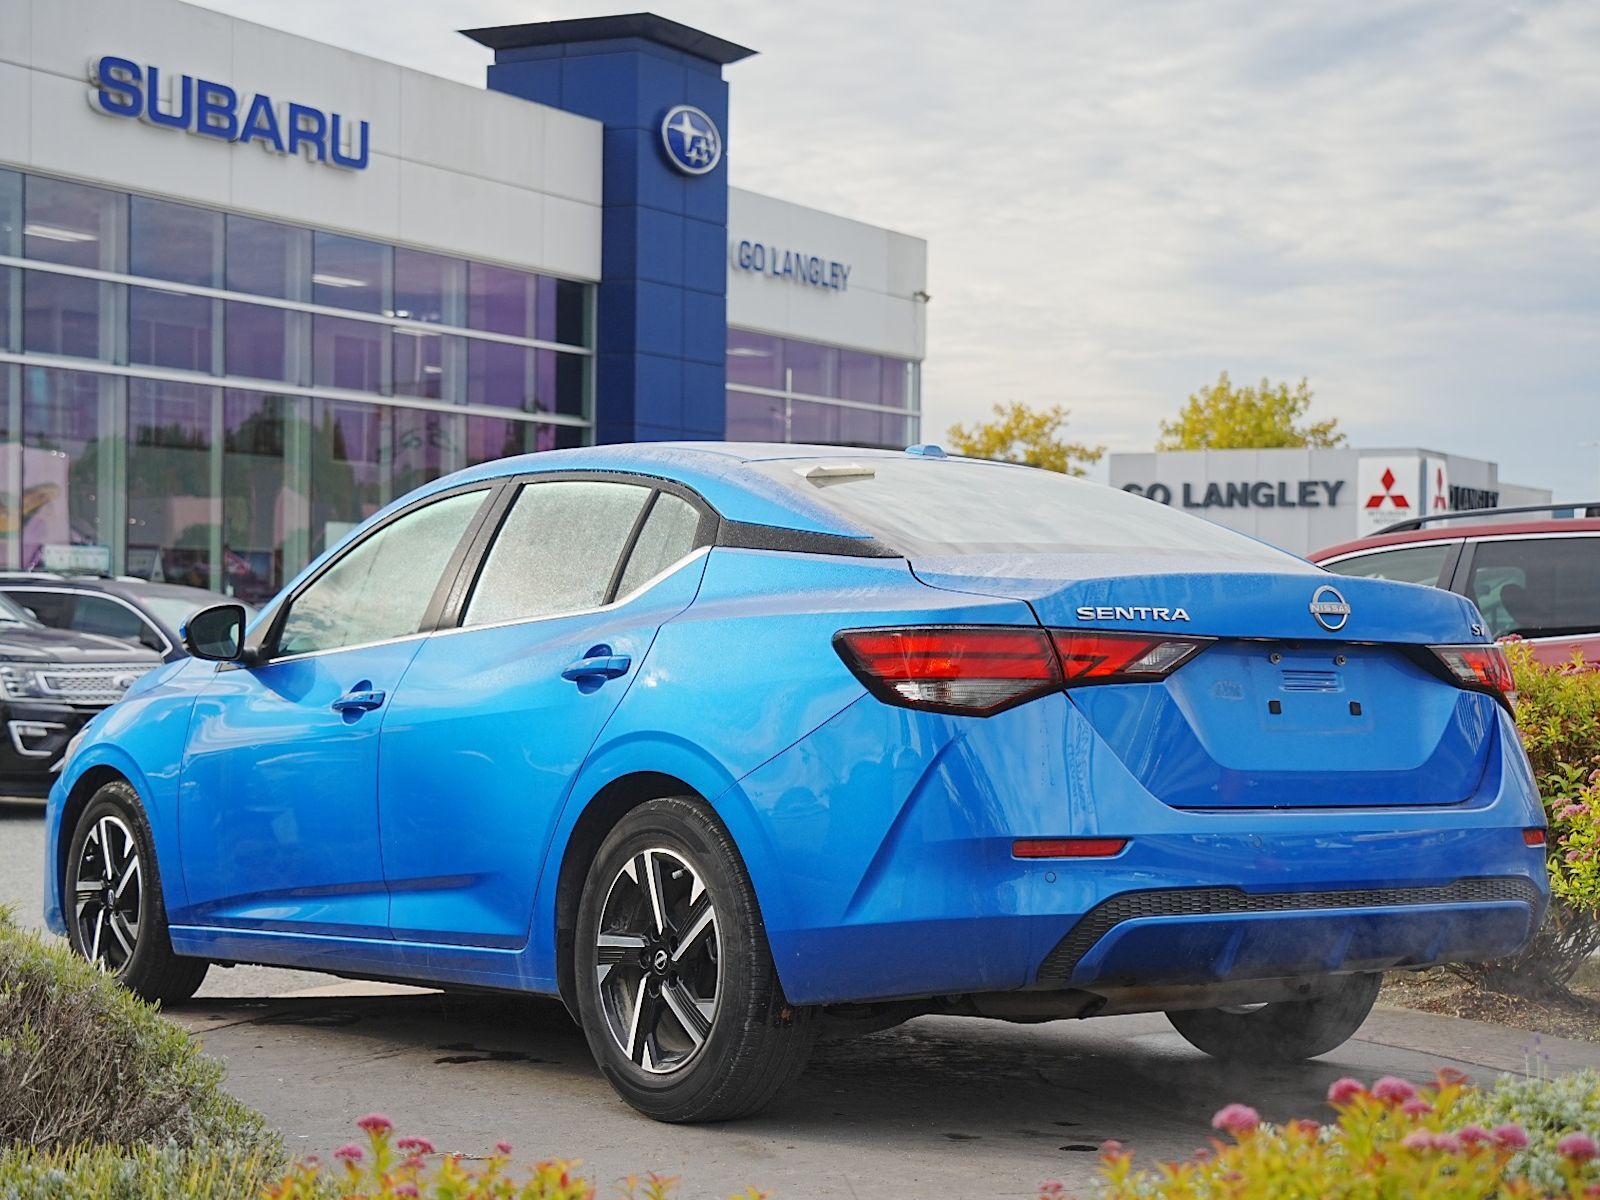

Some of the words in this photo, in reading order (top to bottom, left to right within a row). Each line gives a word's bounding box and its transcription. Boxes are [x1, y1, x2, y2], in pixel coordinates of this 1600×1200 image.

[97, 55, 370, 170] SUBARU
[738, 240, 765, 272] GO
[771, 246, 851, 291] LANGLEY
[1182, 480, 1345, 508] LANGLEY
[1076, 606, 1191, 621] SENTRA
[1310, 602, 1350, 614] NISSAN
